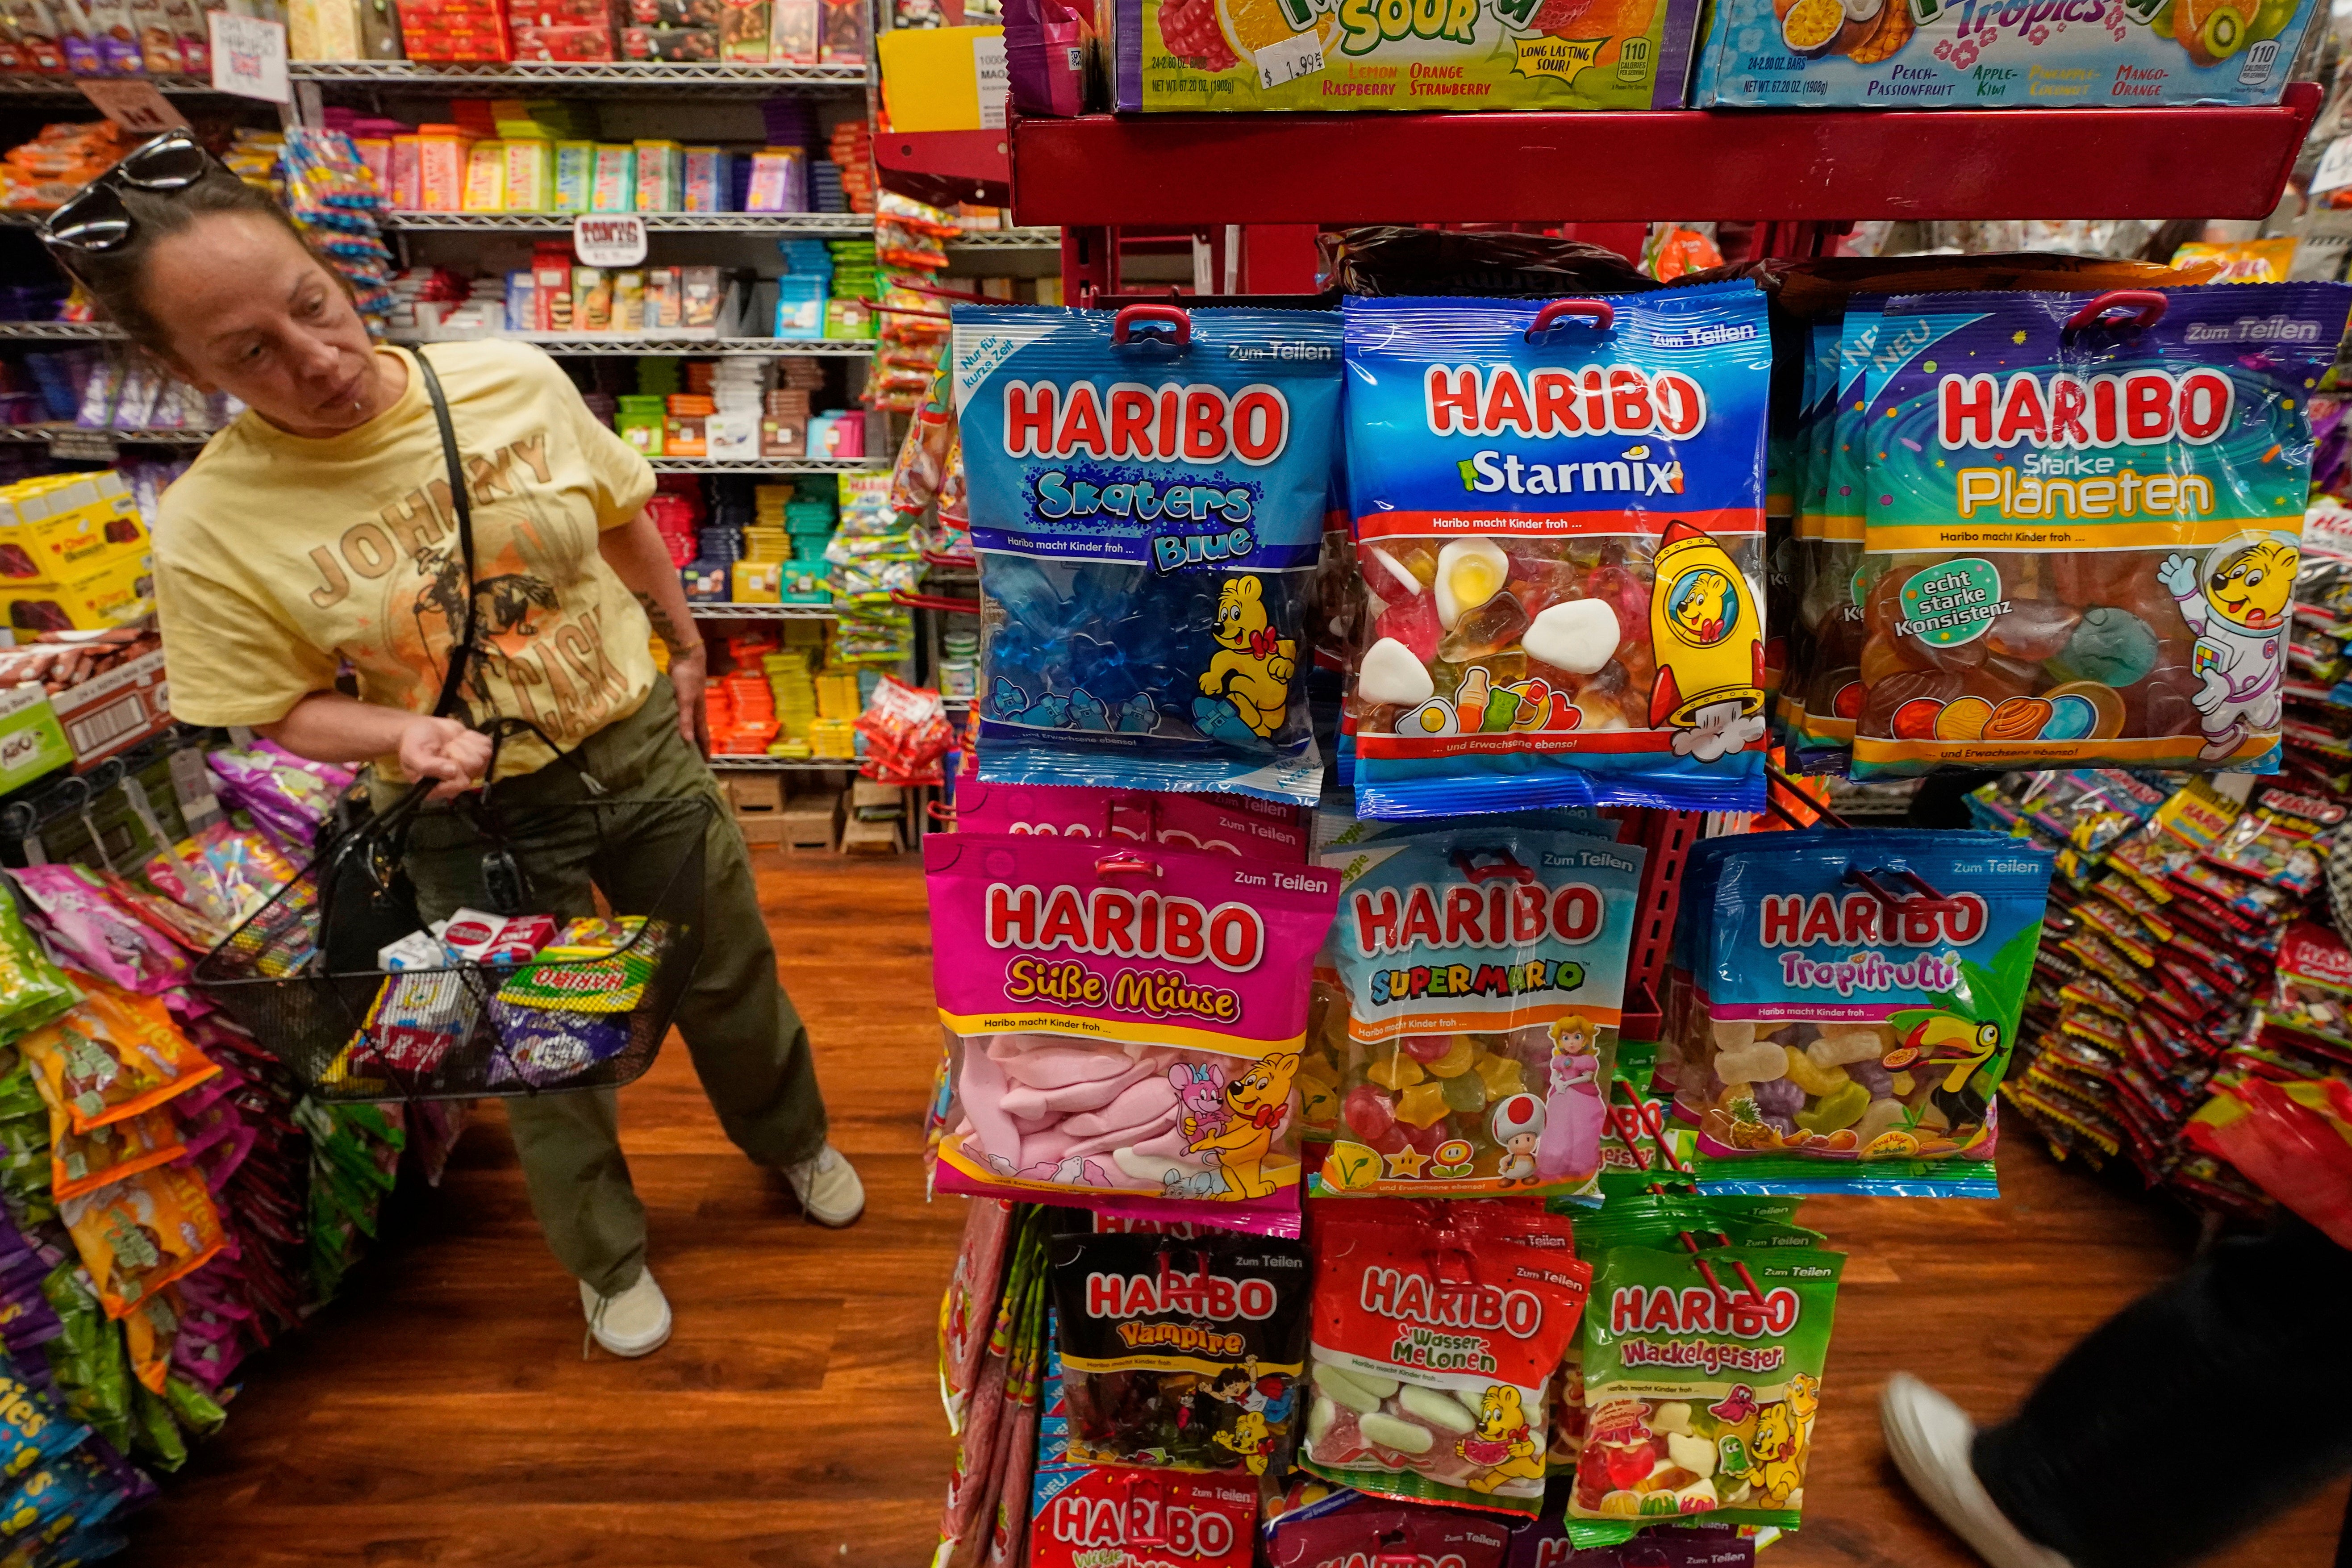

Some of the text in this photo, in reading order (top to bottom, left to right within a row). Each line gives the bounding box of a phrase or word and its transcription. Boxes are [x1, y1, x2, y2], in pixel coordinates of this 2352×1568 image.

[1339, 0, 1480, 55] SOUR
[1944, 0, 2106, 38] Tropics
[1152, 57, 1176, 69] 24-2.80
[1178, 57, 1188, 68] OZ.
[1521, 46, 1589, 61] LONG LASTING
[1626, 43, 1646, 60] 110
[2250, 46, 2274, 62] 110
[1265, 69, 1272, 87] $
[1287, 55, 1314, 80] 1.99
[1348, 63, 1463, 79] LEMON ORANGE
[1536, 59, 1570, 75] SOUR!
[1748, 57, 1806, 70] 24-2.80 OZ. BARS
[1892, 65, 1938, 81] PEACH-
[1973, 65, 2018, 80] APPLE-
[2115, 65, 2169, 80] MANGO-
[1152, 80, 1234, 94] NET WT. 67.20 OZ. (1908g)
[1322, 80, 1491, 96] RASPBERRY STRAWBERRY
[1744, 80, 1828, 95] NET WT. 67.20 OZ. (1908g)
[1867, 80, 1955, 96] PASSIONFRUIT
[1977, 83, 2006, 96] KIWI
[2111, 83, 2162, 96] ORANGE
[1652, 324, 1755, 347] Zum Teilen
[2189, 318, 2317, 341] Zum Teilen
[961, 333, 997, 370] Nur für
[1229, 342, 1331, 361] Zum Teilen
[1873, 319, 1931, 374] NEU
[962, 339, 1014, 388] kurze Zeit
[1426, 365, 1705, 439] HARIBO
[1940, 370, 2234, 449] HARIBO
[1005, 381, 1287, 464] HARIBO
[1473, 449, 1673, 496] Starmix
[2023, 452, 2115, 476] Starke
[1037, 470, 1252, 522] Skaters
[1961, 471, 2210, 516] Planeten
[1433, 517, 1568, 530] Haribo macht Kinder froh
[1008, 536, 1123, 554] Haribo macht Kinder froh
[1940, 531, 2071, 543] Haribo macht Kinder froh
[1155, 528, 1253, 572] Blue
[1923, 569, 1971, 596] echt
[1918, 587, 1988, 616] starke
[1895, 599, 2013, 638] Konsistenz
[1447, 739, 1577, 751] und Erwachsene ebenso!
[1965, 749, 2028, 757] Erwachsene
[1243, 796, 1287, 817] Teilen
[1219, 817, 1296, 845] Zum Teilen
[1544, 853, 1633, 871] Zum Teilen
[1954, 860, 2039, 874] Zum Teilen
[1234, 871, 1328, 893] Zum Teilen
[987, 884, 1263, 971] HARIBO
[1352, 882, 1603, 957] HARIBO
[1761, 894, 1987, 947] HARIBO
[1371, 959, 1585, 1006] SUPER MARIO
[1780, 951, 1959, 997] Tropifrutti
[1009, 959, 1235, 1022] Süße Mäuse
[1759, 1008, 1864, 1017] Haribo macht Kinder froh
[984, 1018, 1100, 1032] Haribo macht Kinder froh
[1359, 1018, 1456, 1037] Haribo macht Kinder froh
[1772, 1236, 1809, 1246] Teilen
[1236, 1255, 1302, 1268] Zum Teilen
[1764, 1267, 1831, 1277] Zum Teilen
[1517, 1266, 1583, 1292] Zum Teilen
[1087, 1272, 1276, 1320] HARIBO
[1361, 1267, 1541, 1338] HARIBO
[1612, 1286, 1799, 1339] HARIBO
[1118, 1322, 1245, 1356] Vampire
[1412, 1328, 1481, 1351] Wasser
[1392, 1341, 1497, 1373] Melonen
[1622, 1339, 1785, 1374] Wackelgeister
[1352, 1358, 1375, 1370] Haribo
[1399, 1369, 1421, 1379] Kinder
[1654, 1385, 1677, 1393] Kinder
[1038, 1474, 1068, 1500] NEU
[1192, 1487, 1251, 1503] Zum Teilen
[1055, 1497, 1232, 1556] HARIBO
[1687, 1553, 1745, 1564] Zum Teilen
